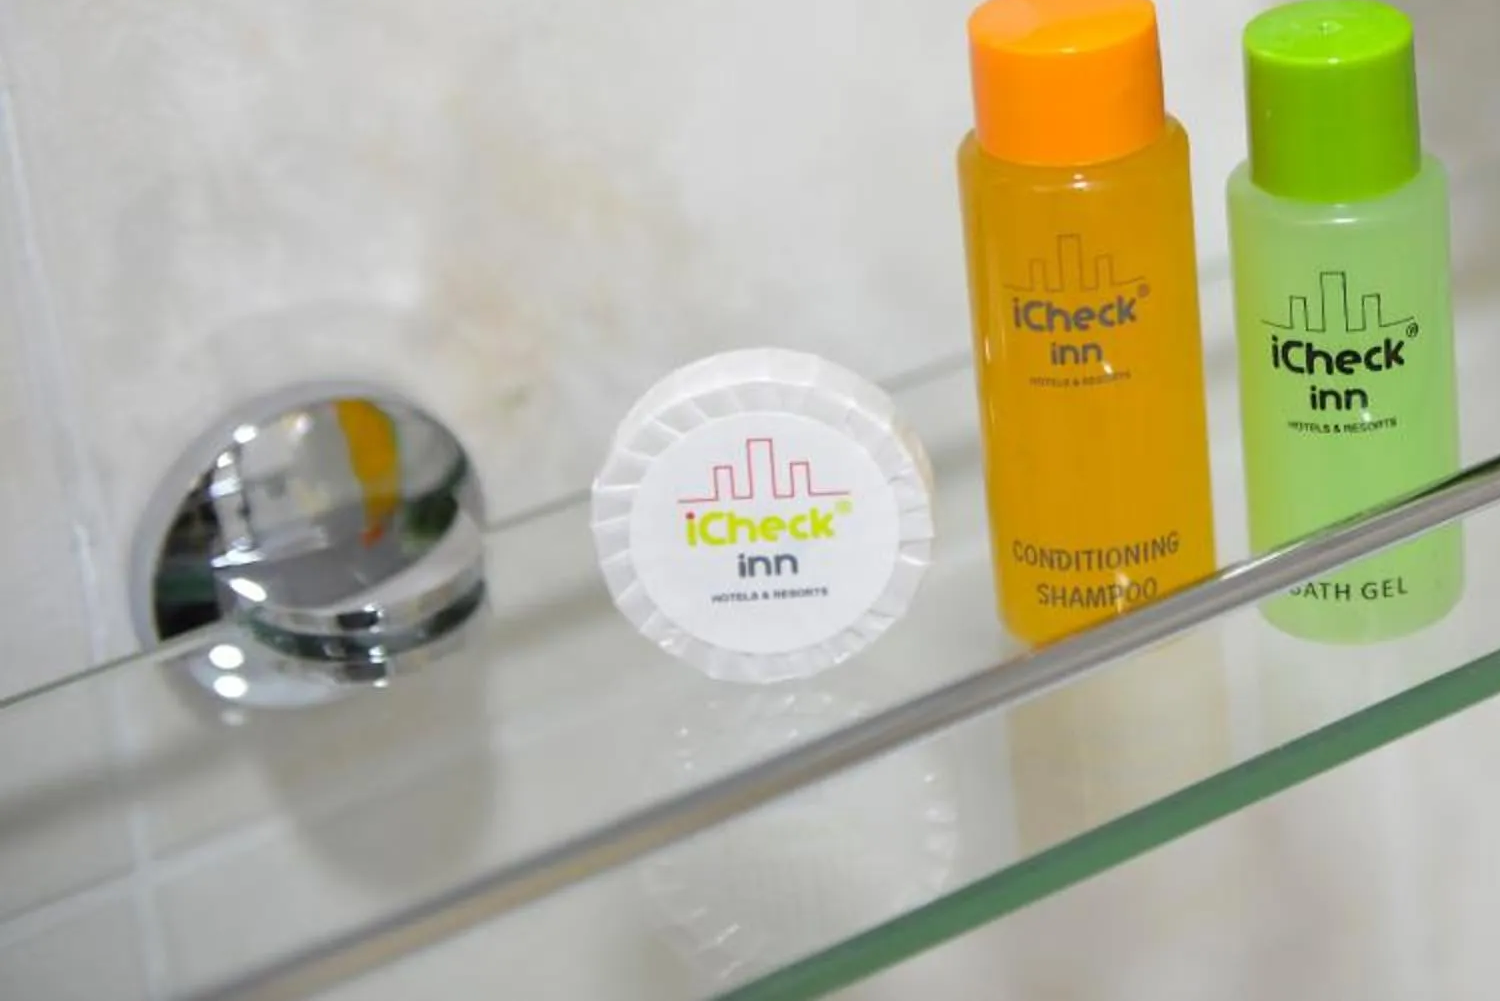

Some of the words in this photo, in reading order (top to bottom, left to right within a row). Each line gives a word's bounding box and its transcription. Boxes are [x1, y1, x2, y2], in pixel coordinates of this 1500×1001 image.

[1050, 342, 1103, 365] inn
[1310, 385, 1369, 410] inn
[1012, 531, 1180, 572] CONDITIONING
[737, 553, 799, 578] inn
[1036, 577, 1158, 609] SHAMPOO
[1361, 576, 1409, 600] GEL
